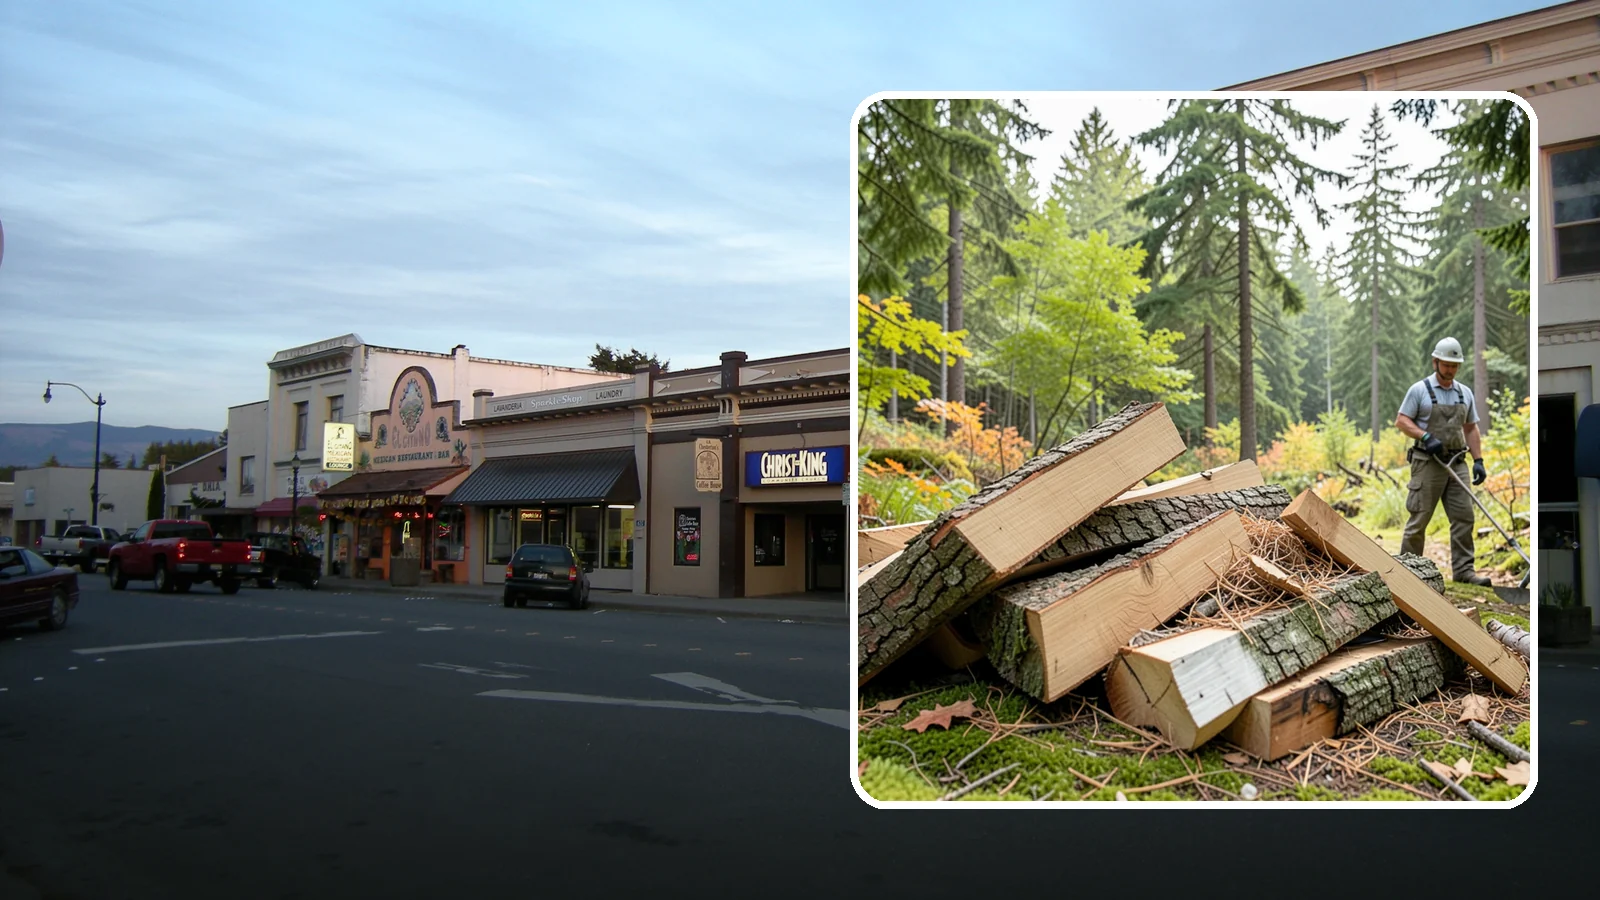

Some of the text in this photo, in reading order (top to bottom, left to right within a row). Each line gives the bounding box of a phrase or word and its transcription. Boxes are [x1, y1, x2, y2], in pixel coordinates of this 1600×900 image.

[562, 395, 582, 405] Shop
[595, 389, 623, 400] LAUNDRY
[493, 402, 522, 412] LAVANDERIA
[373, 454, 396, 464] MEXICAN
[397, 451, 433, 462] RESTAURANT
[438, 450, 450, 459] BAR
[799, 450, 827, 476] KING
